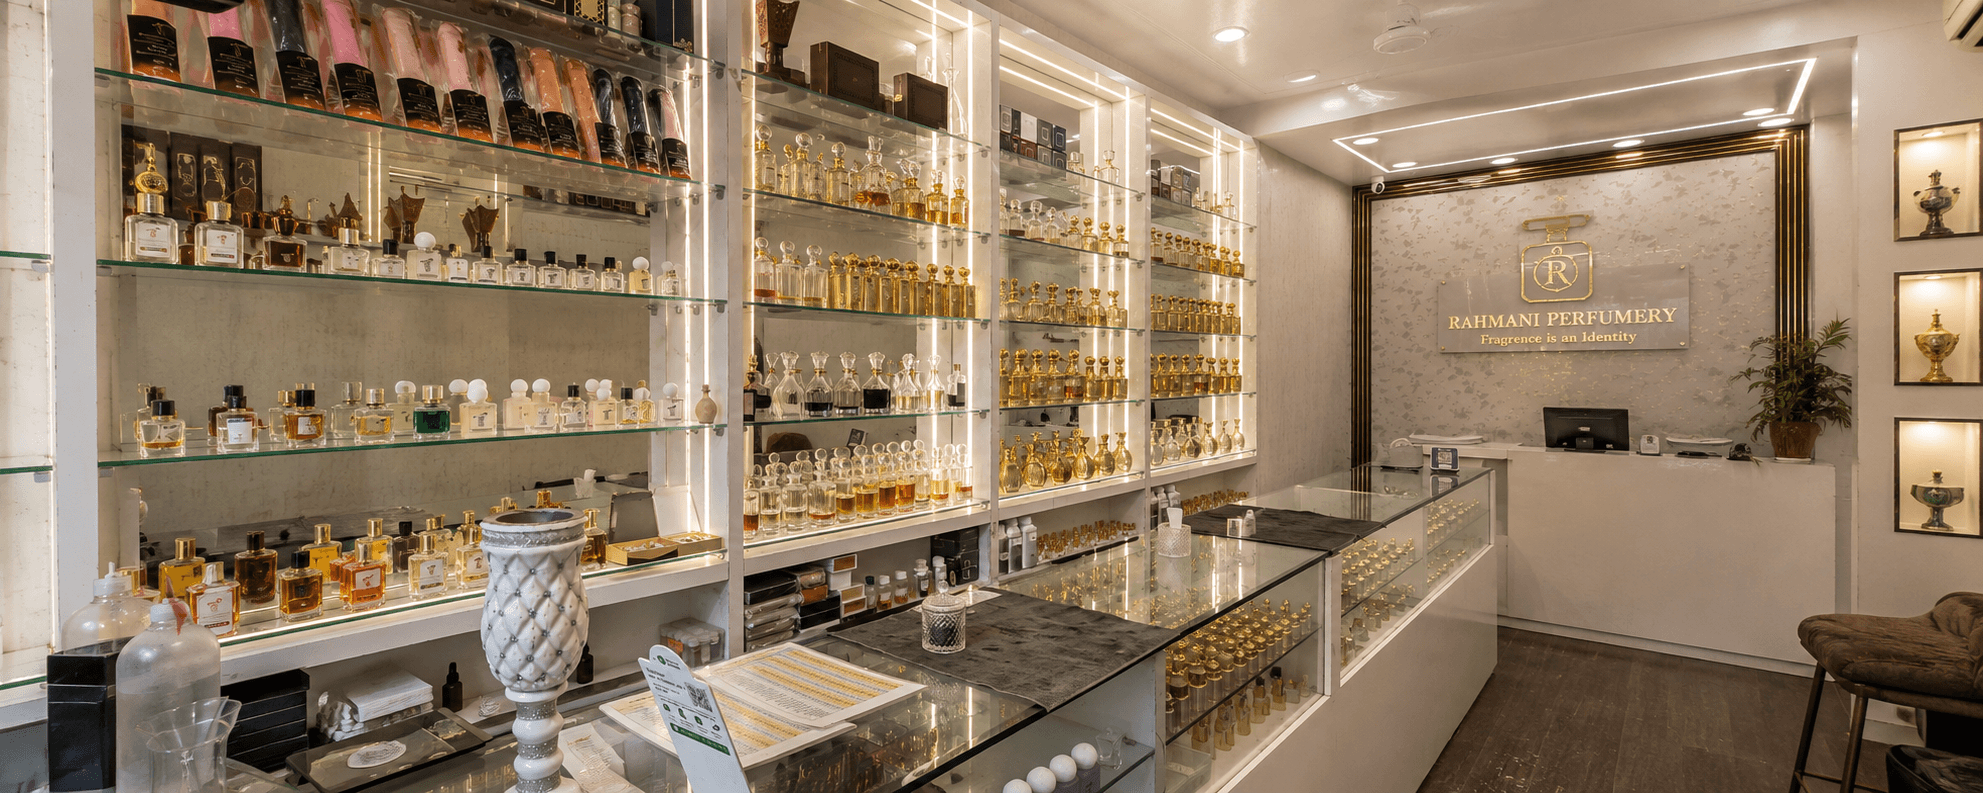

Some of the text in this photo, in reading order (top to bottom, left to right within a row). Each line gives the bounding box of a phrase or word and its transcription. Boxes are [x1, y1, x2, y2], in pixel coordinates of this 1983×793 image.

[1545, 260, 1572, 285] R
[1448, 307, 1677, 330] RAHMANI PERFUMERY
[1480, 331, 1638, 347] Fragrence is an Identity
